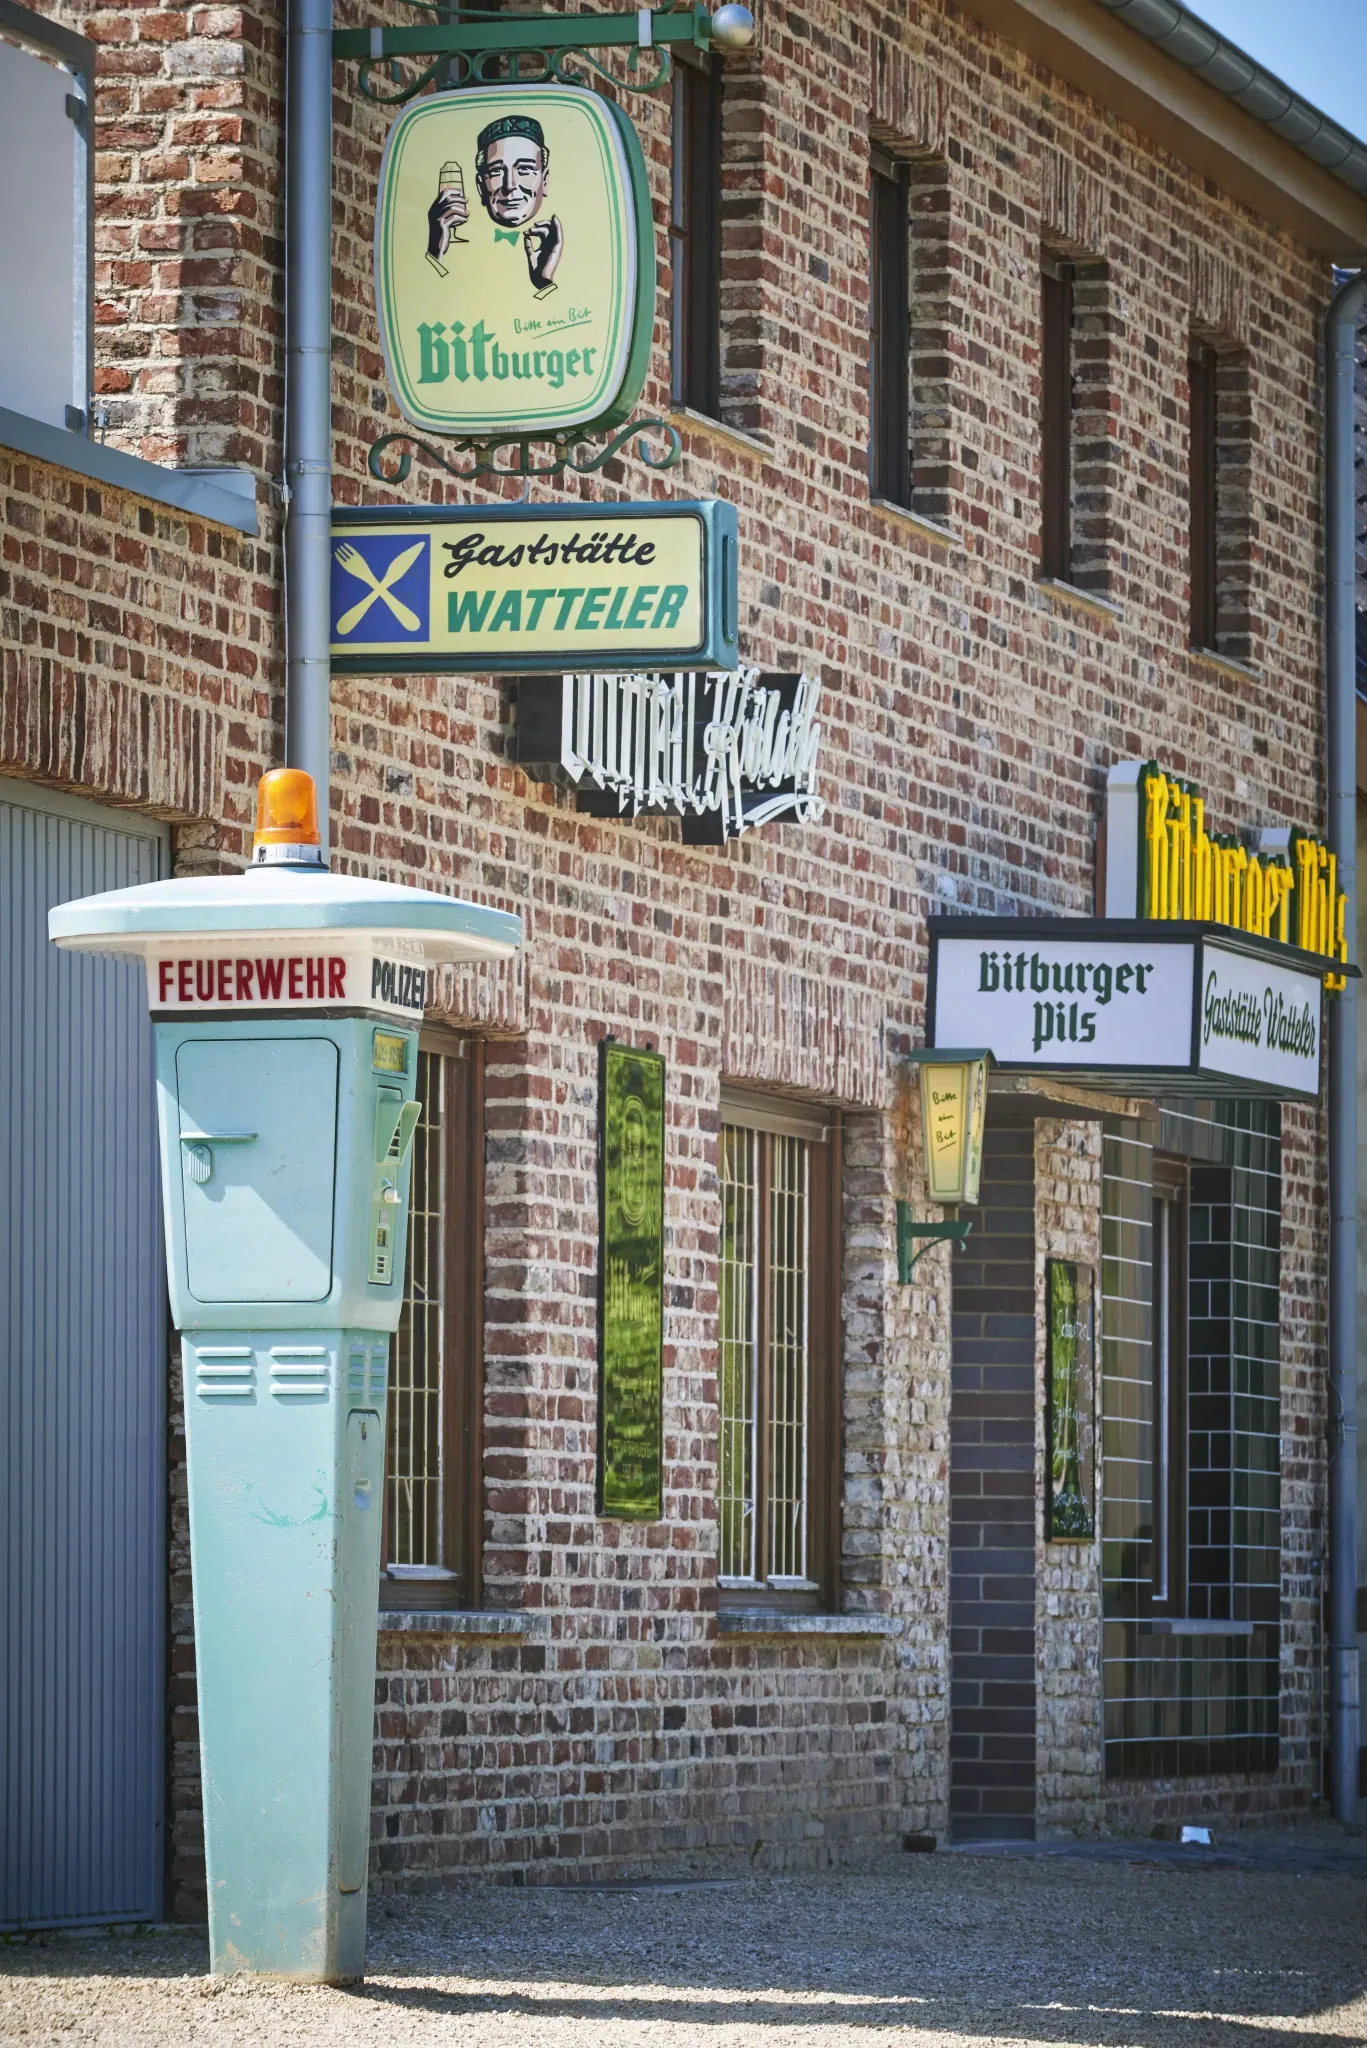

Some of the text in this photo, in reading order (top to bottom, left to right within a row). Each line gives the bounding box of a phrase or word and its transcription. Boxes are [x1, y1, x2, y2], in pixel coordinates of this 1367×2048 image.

[513, 307, 593, 335] Bitte ein Bit
[416, 318, 598, 390] Bitburger
[441, 531, 657, 579] Gaststätte
[447, 583, 689, 633] WATTELER
[158, 956, 347, 1003] FEUERWEHR
[371, 957, 427, 1012] POLIZEI
[977, 951, 1155, 1005] Bitburger
[1030, 1000, 1098, 1054] Pils
[1203, 969, 1316, 1059] Gaststätte Watteler
[931, 1091, 958, 1106] Bitte
[937, 1113, 955, 1123] ein
[935, 1130, 957, 1144] Bit
